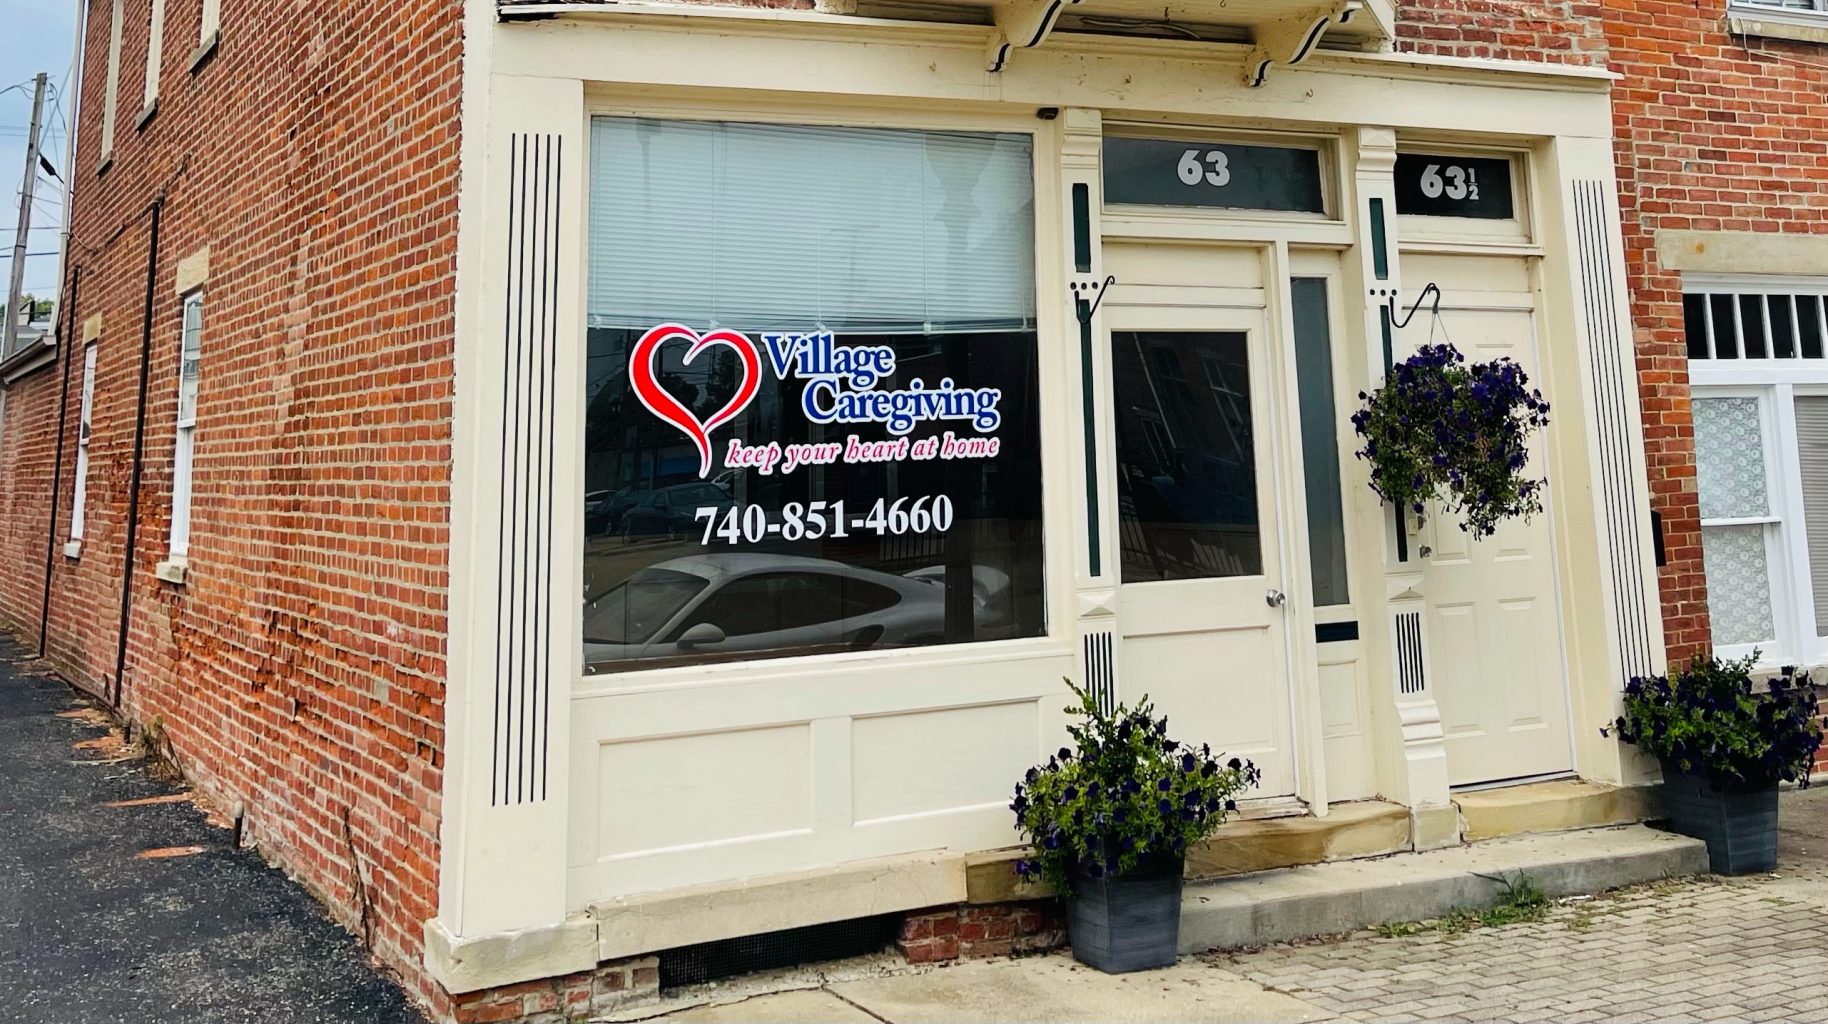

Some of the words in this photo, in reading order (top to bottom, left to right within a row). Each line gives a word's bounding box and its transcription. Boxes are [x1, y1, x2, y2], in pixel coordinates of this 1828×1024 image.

[1176, 149, 1231, 187] 63
[763, 333, 894, 386] Village
[803, 378, 1000, 434] Caregiving
[726, 440, 779, 473] keep
[783, 443, 839, 472] your
[845, 436, 907, 462] heart
[913, 437, 938, 458] at
[943, 433, 999, 458] home
[695, 495, 953, 545] 740-851-4660
